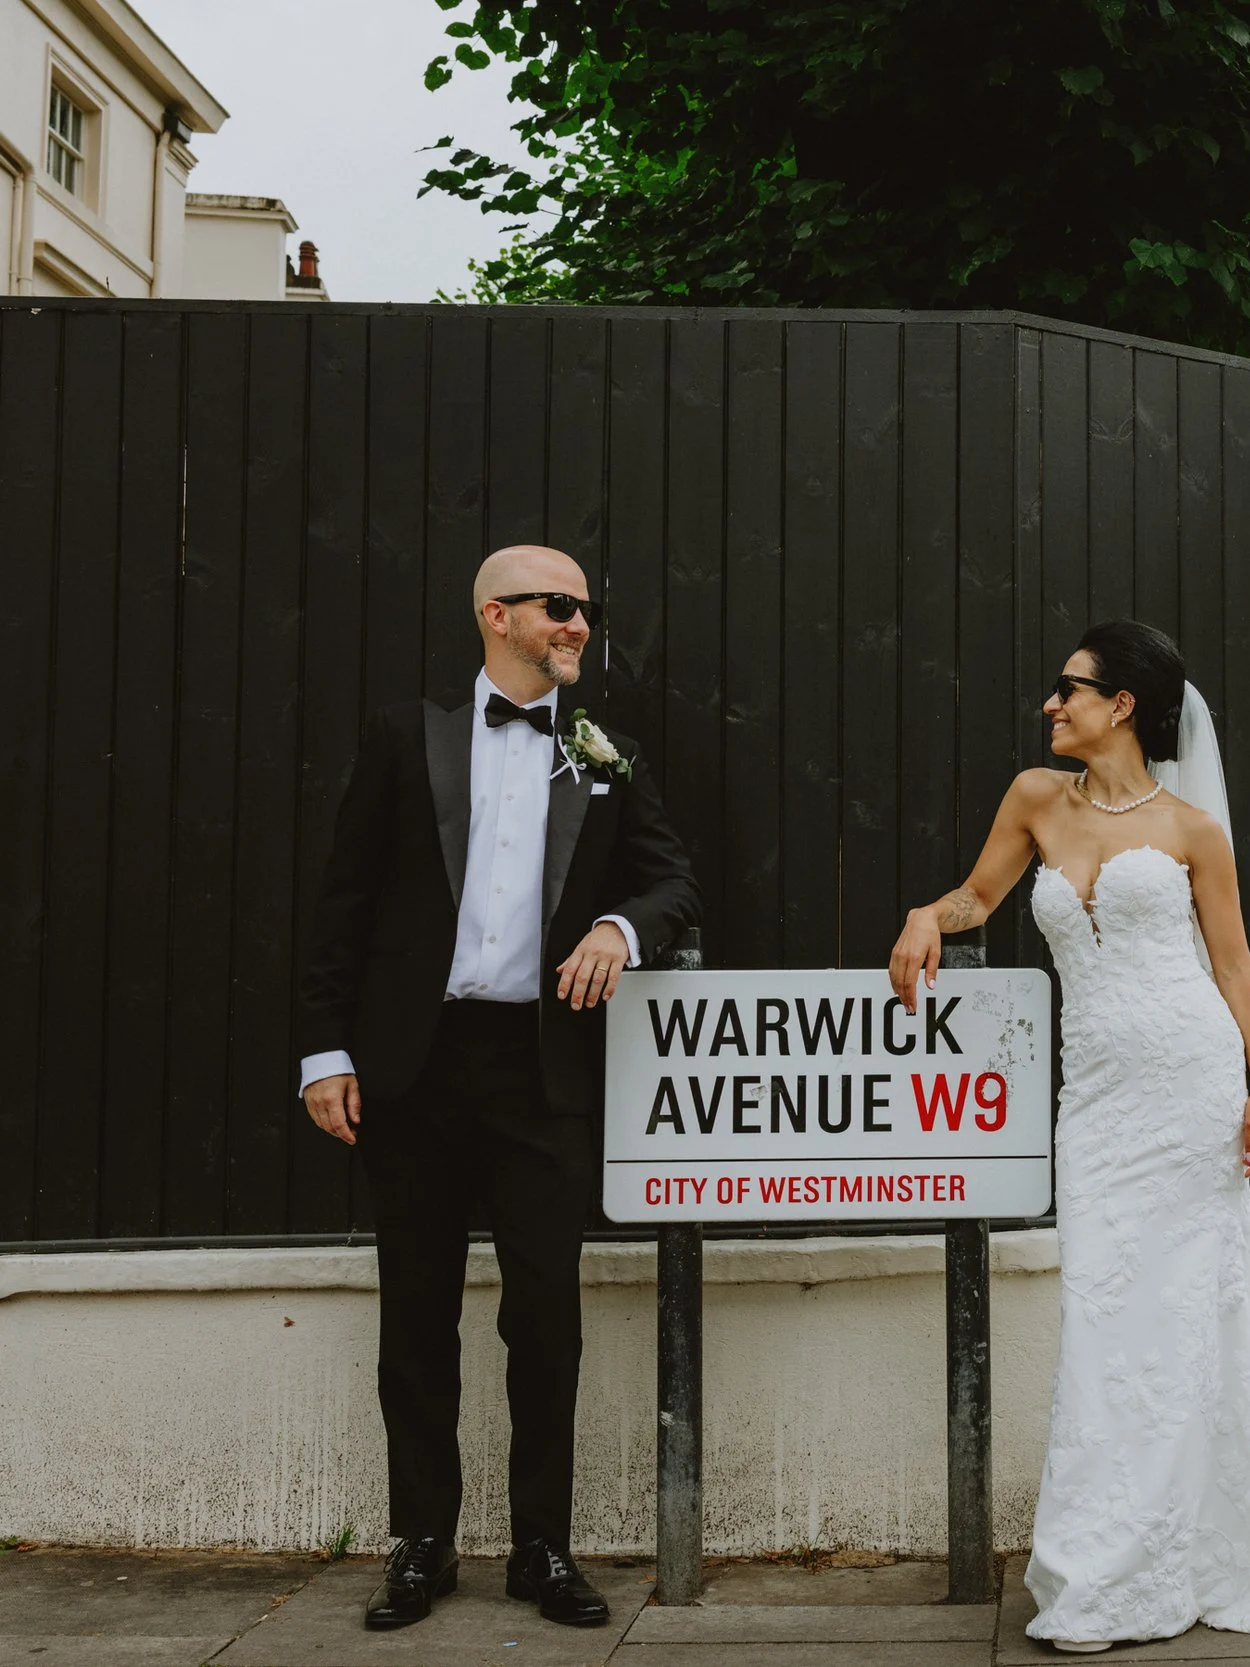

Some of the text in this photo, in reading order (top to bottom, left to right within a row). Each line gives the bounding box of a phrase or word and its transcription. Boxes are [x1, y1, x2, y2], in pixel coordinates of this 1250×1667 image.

[647, 997, 963, 1057] WARWICK
[646, 1072, 1007, 1135] AVENUE W9
[645, 1174, 965, 1205] CITY OF WESTMINSTER
